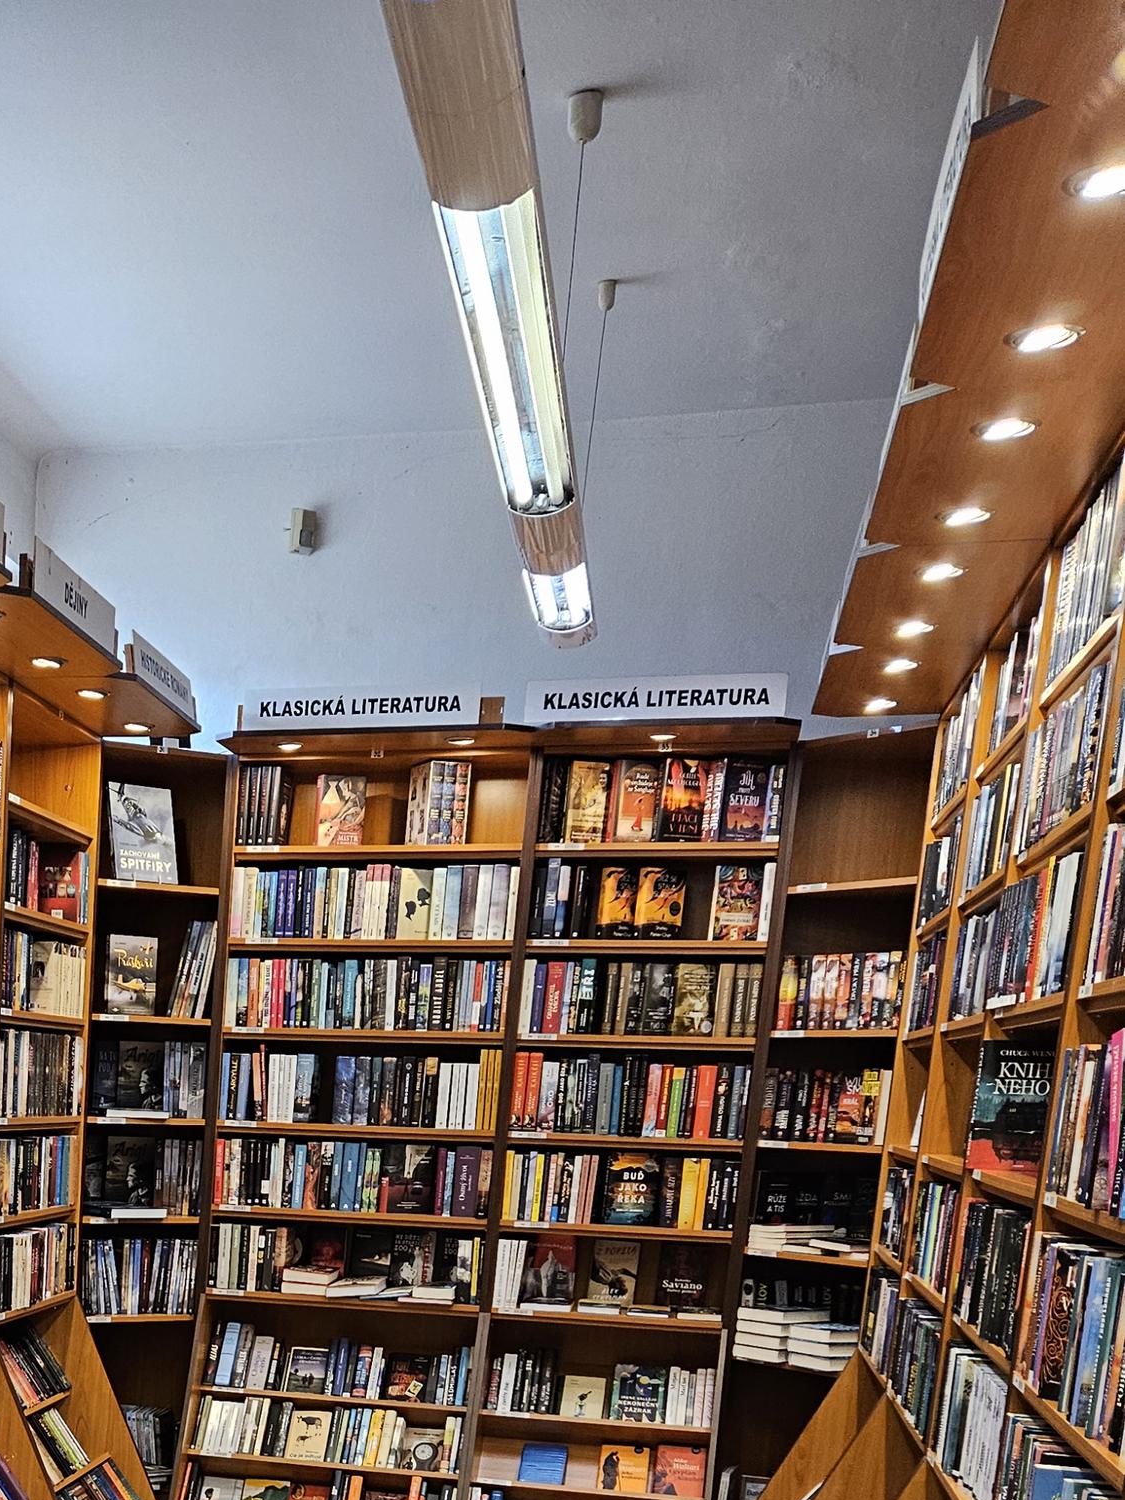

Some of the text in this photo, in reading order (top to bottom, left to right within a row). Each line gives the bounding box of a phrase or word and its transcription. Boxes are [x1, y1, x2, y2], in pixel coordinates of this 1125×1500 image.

[64, 582, 89, 619] DĚJINY
[140, 649, 170, 688] HISTORICKÉ
[543, 687, 771, 711] KLASICKÁ LITERATURA
[259, 695, 462, 718] KLASICKÁ LITERATURA
[729, 793, 760, 807] SEVERU
[120, 849, 160, 860] ZACHOVANÉ
[120, 857, 172, 873] SPITFIRY
[623, 1170, 645, 1180] BUĎ
[618, 1183, 647, 1192] JAKO
[617, 1193, 645, 1205] ŘEKA
[662, 1280, 703, 1291] Saviano
